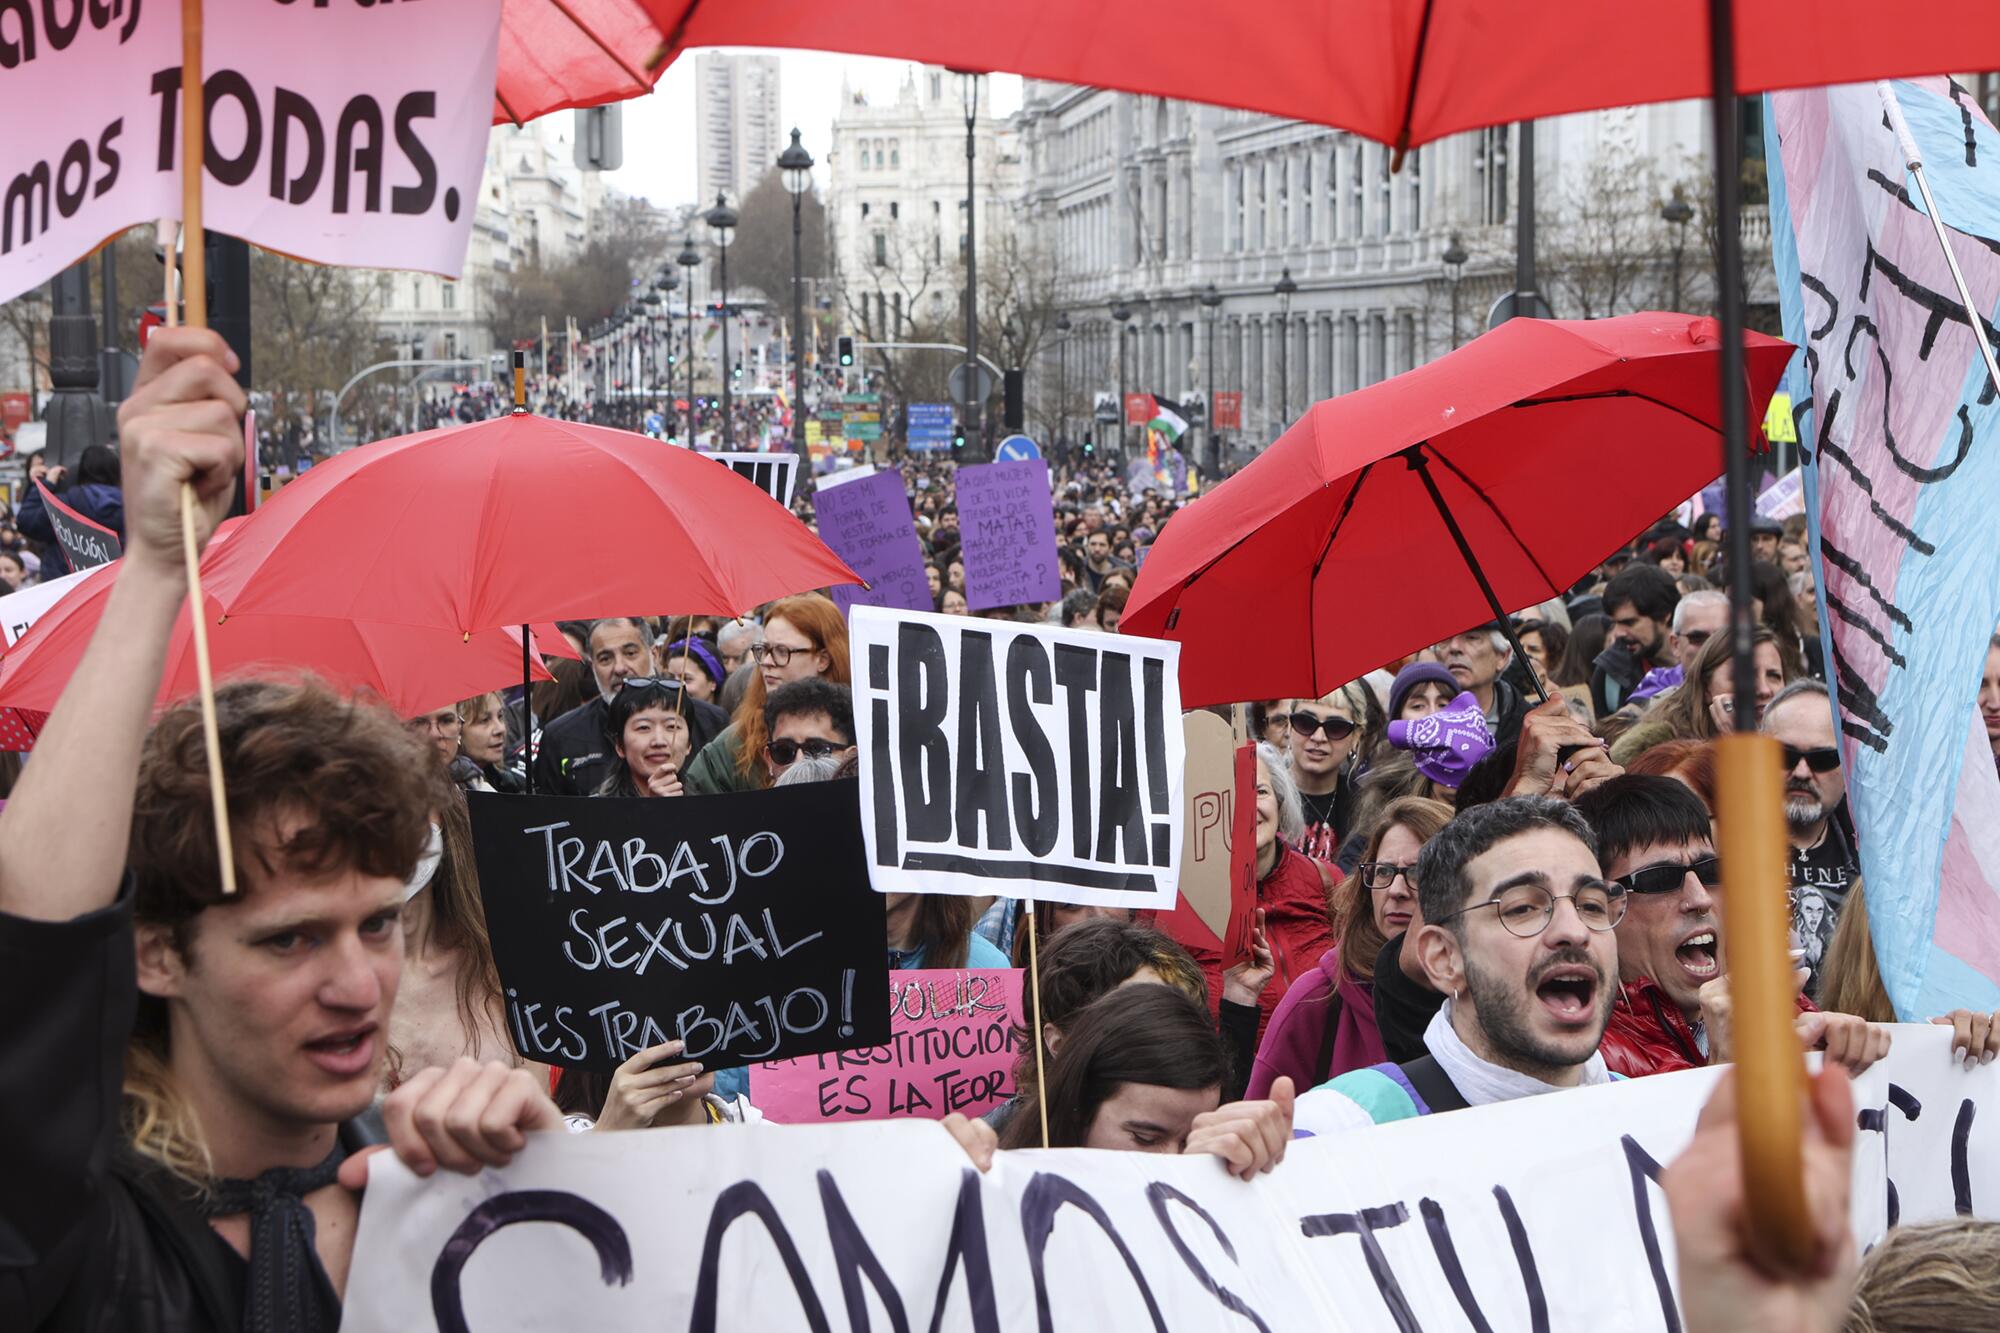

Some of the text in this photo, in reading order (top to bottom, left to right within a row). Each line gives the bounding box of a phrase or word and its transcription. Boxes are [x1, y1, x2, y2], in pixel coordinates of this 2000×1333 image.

[150, 66, 460, 223] TODAS.
[994, 466, 1033, 482] MUJER
[840, 488, 857, 506] ES
[859, 480, 876, 497] MI
[970, 485, 1031, 505] DE TU VIDA
[870, 499, 889, 516] DE
[963, 500, 1030, 521] TIENEN QUE
[895, 524, 912, 538] DE
[977, 513, 1037, 537] MATAR
[965, 530, 1039, 551] PARA QUE TE
[969, 546, 1028, 566] IMPORTE LA
[970, 560, 1021, 580] VIOLENCIA
[972, 569, 1031, 596] MACHISTA
[867, 620, 1171, 869] ¡BASTA!
[523, 820, 784, 905] TRABAJO
[562, 906, 823, 975] SEXUAL
[506, 968, 856, 1062] ¡ES TRABAJO!
[818, 1074, 872, 1118] ES
[888, 1078, 933, 1116] LA
